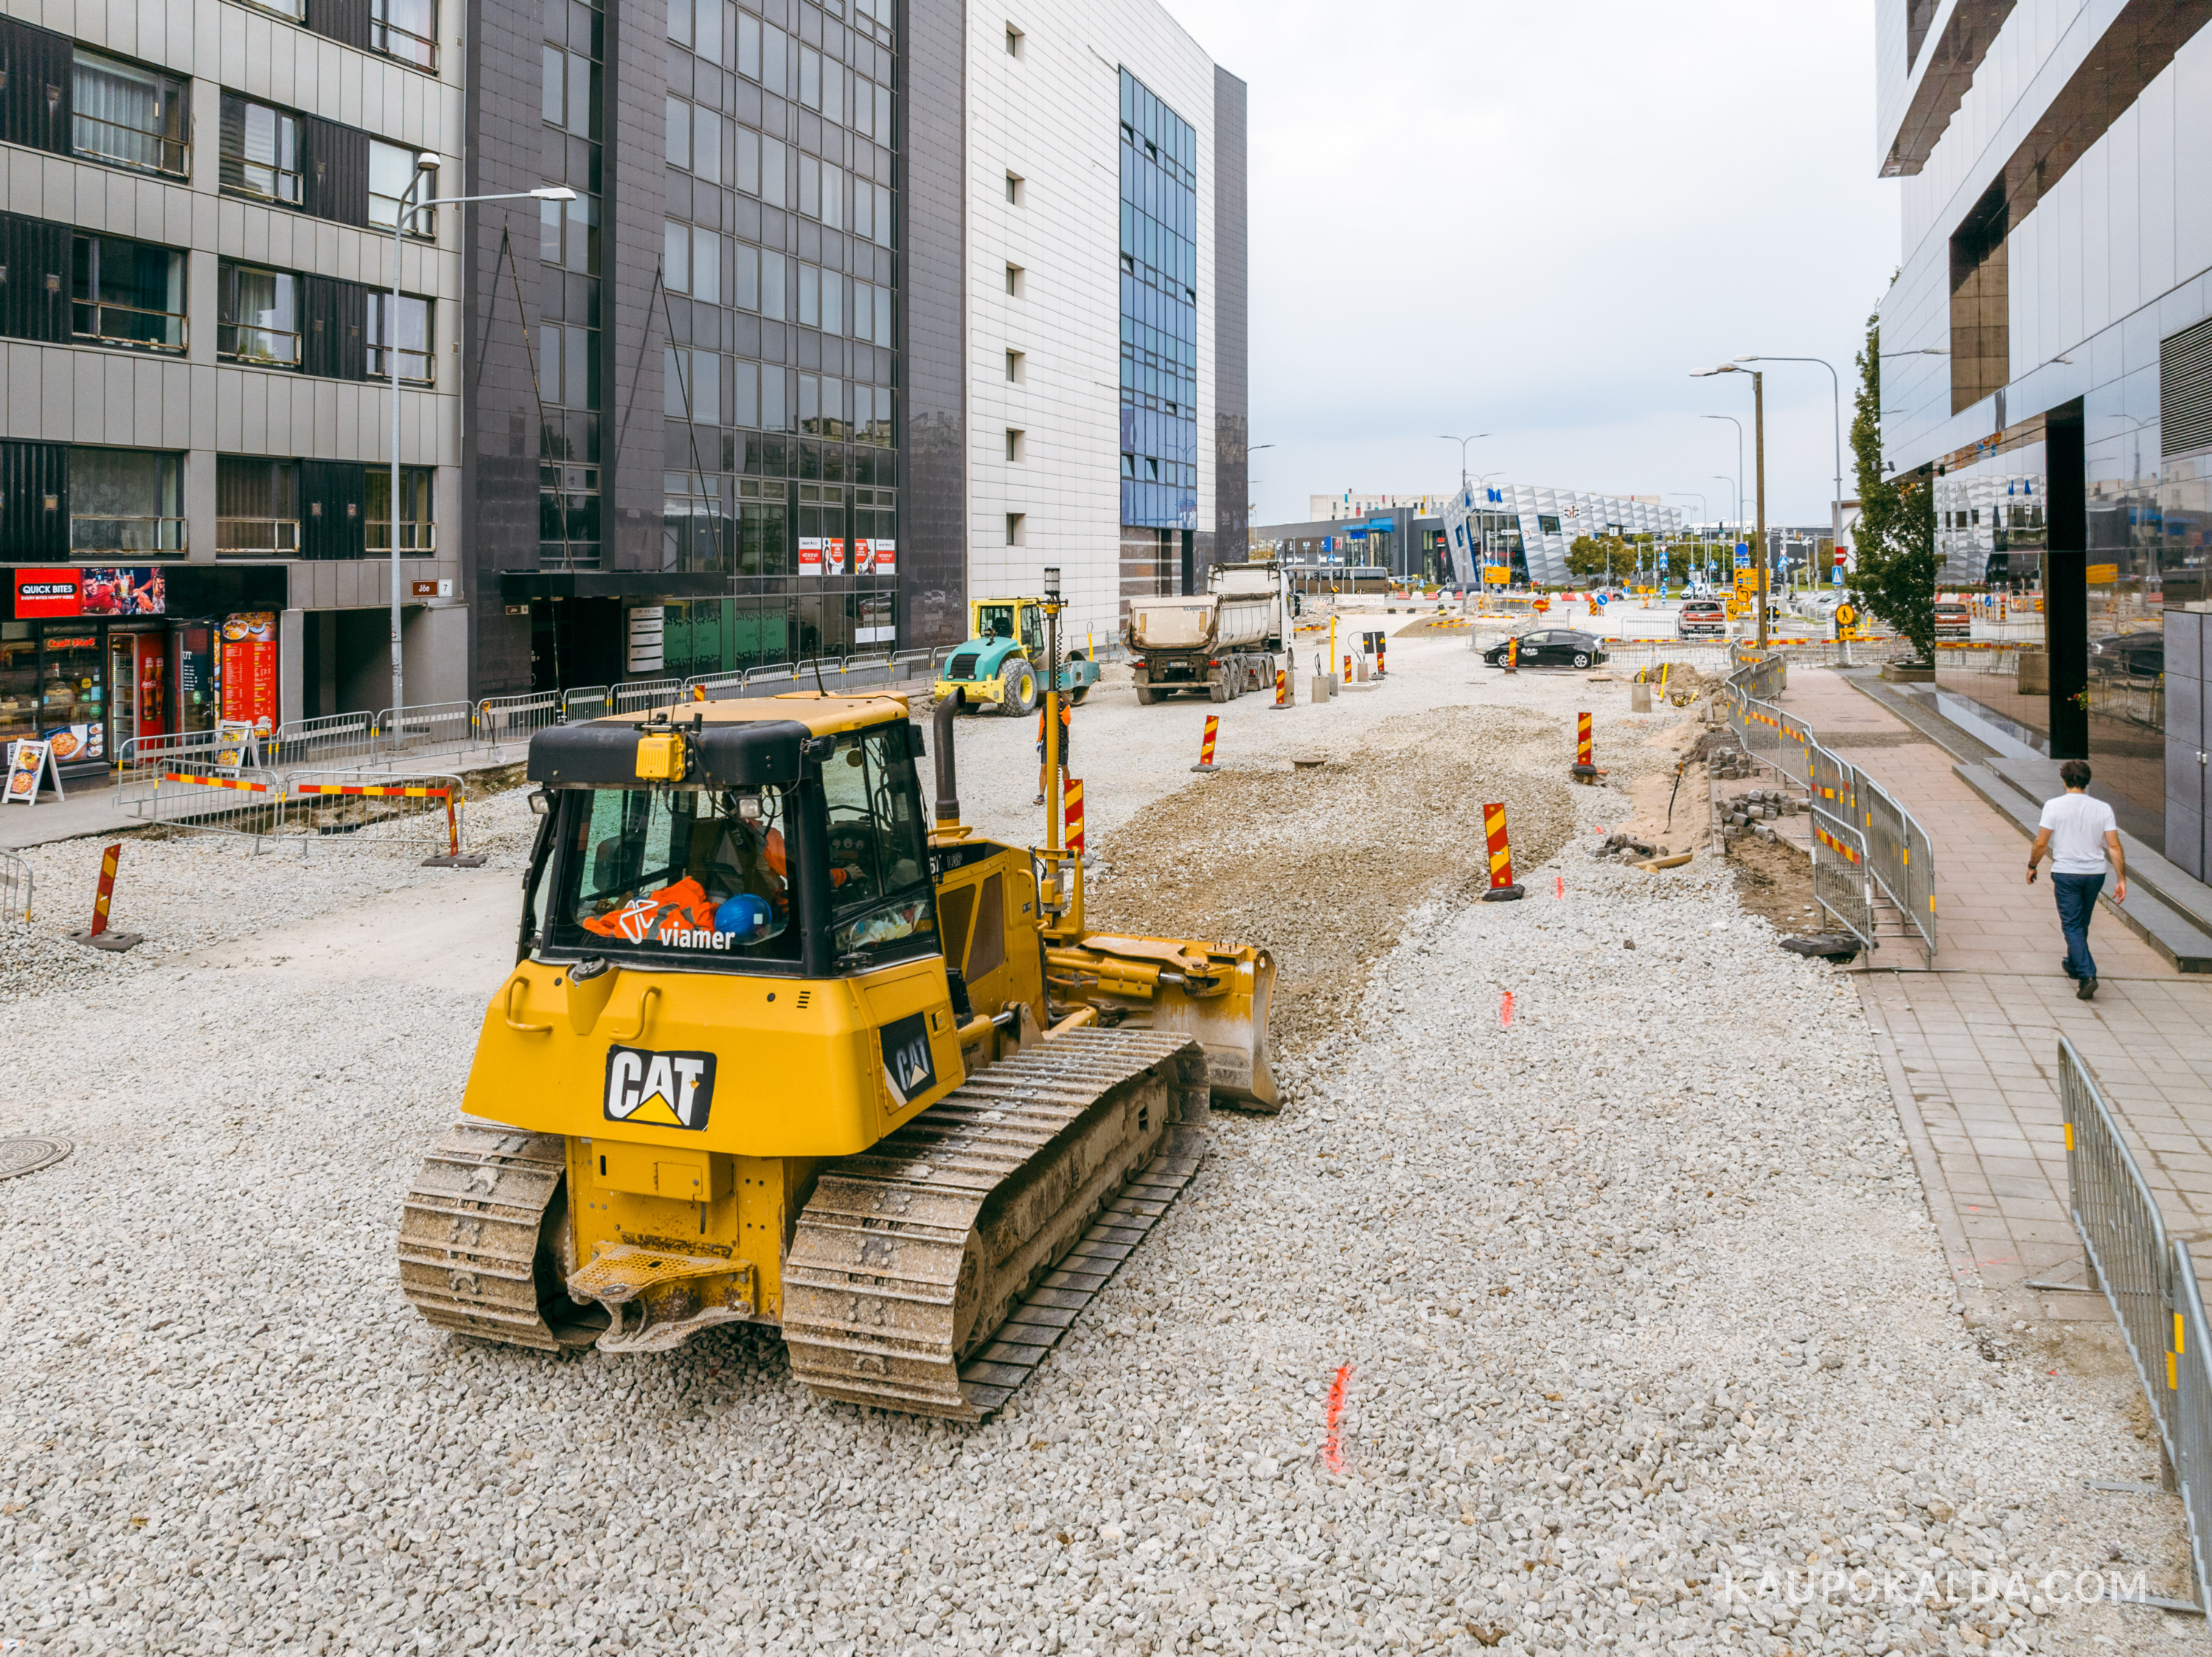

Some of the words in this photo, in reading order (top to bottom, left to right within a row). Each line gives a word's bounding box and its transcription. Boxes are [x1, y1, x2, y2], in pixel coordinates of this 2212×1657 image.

[23, 585, 51, 594] QUICK
[52, 585, 73, 594] BITES
[419, 584, 430, 592] Jõe
[947, 852, 962, 869] LGP
[661, 921, 736, 950] viamer
[896, 1034, 930, 1091] CAT
[608, 1052, 704, 1126] CAT
